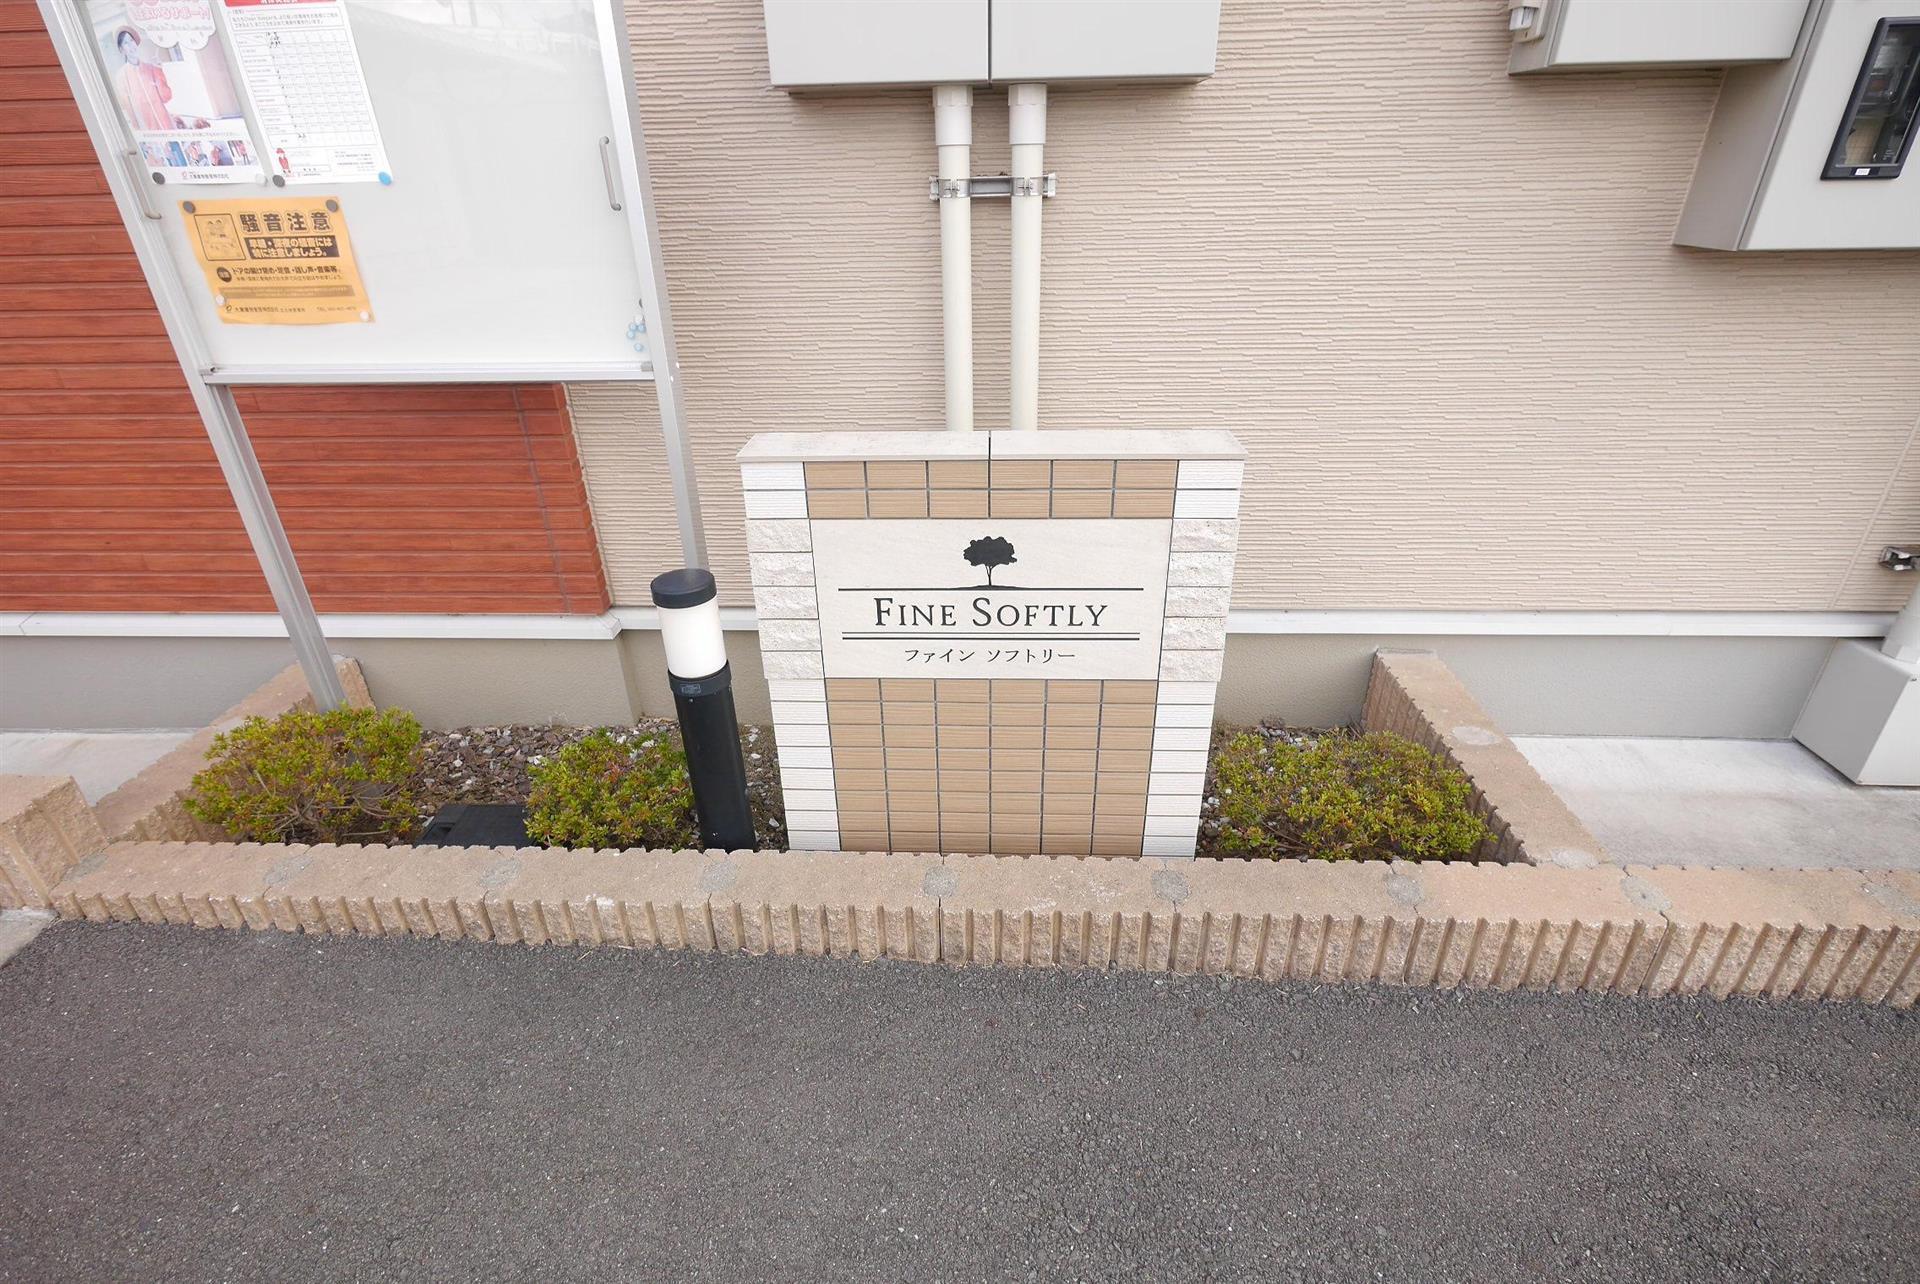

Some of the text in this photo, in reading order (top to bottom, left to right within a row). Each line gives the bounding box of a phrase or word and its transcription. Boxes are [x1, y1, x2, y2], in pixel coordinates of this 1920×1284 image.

[239, 211, 331, 232] 騒音注意
[873, 597, 1108, 627] FINE SOFTLY
[904, 649, 1076, 663] ファイン ソフトリー
